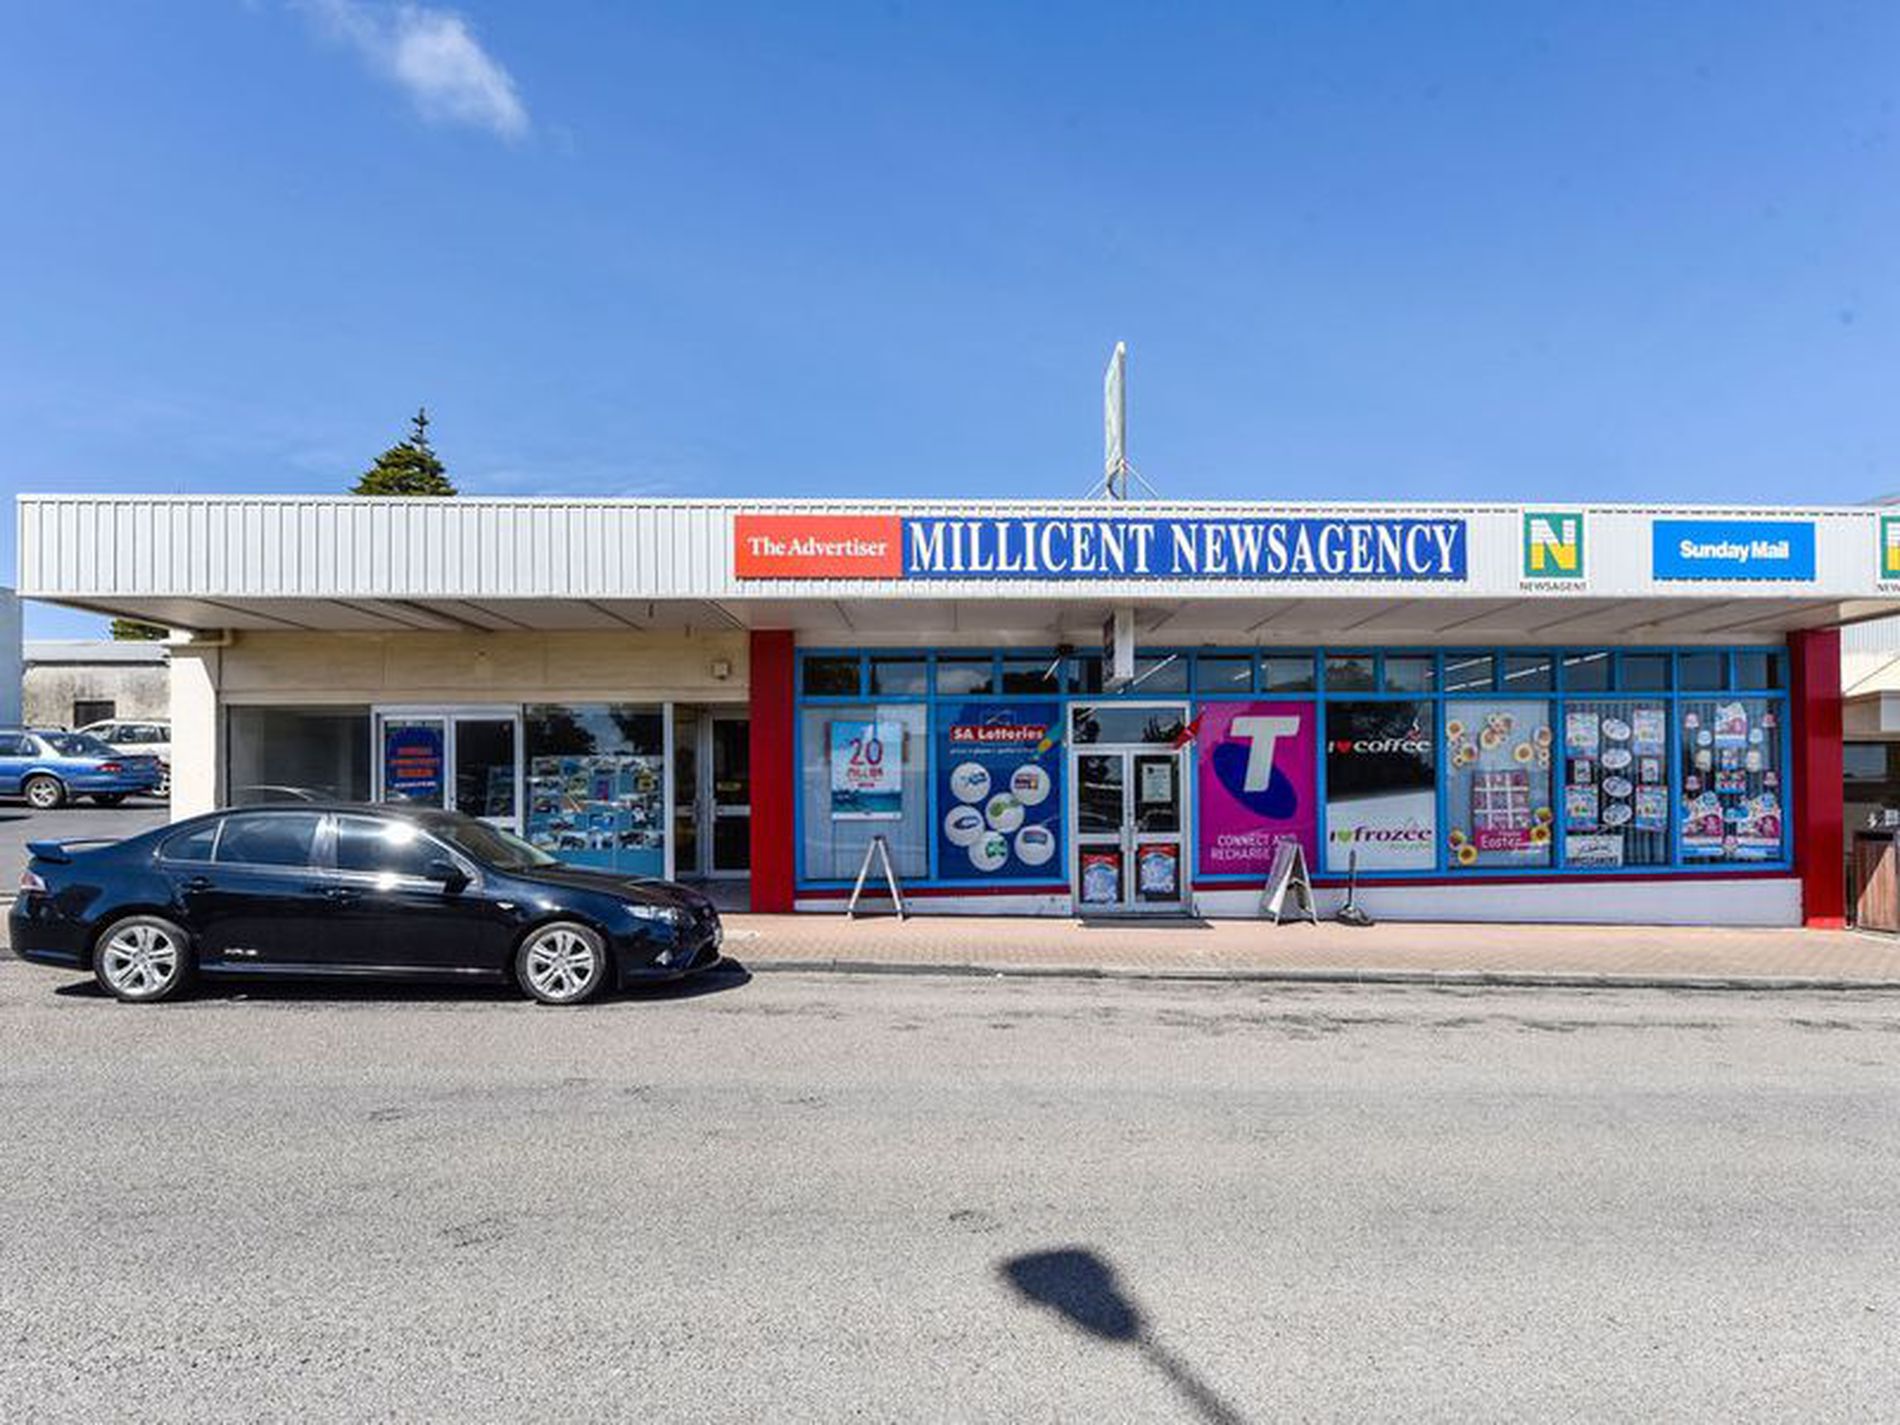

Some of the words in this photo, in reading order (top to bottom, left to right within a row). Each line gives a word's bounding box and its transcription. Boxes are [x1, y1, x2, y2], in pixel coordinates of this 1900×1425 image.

[747, 536, 786, 556] The
[788, 536, 887, 556] Advertiser
[908, 520, 1154, 573] MILLICENT
[1171, 522, 1459, 575] NEWSAGENCY
[1530, 519, 1576, 570] N
[1680, 539, 1749, 563] Sunday
[1751, 540, 1789, 559] Mail
[1519, 582, 1587, 591] NEWSAGENT
[954, 728, 974, 740] SA
[978, 727, 1043, 741] Lotteries
[849, 738, 884, 765] 20
[1230, 715, 1301, 793] T
[1353, 738, 1432, 753] coffee
[1218, 834, 1270, 847] CONNECT
